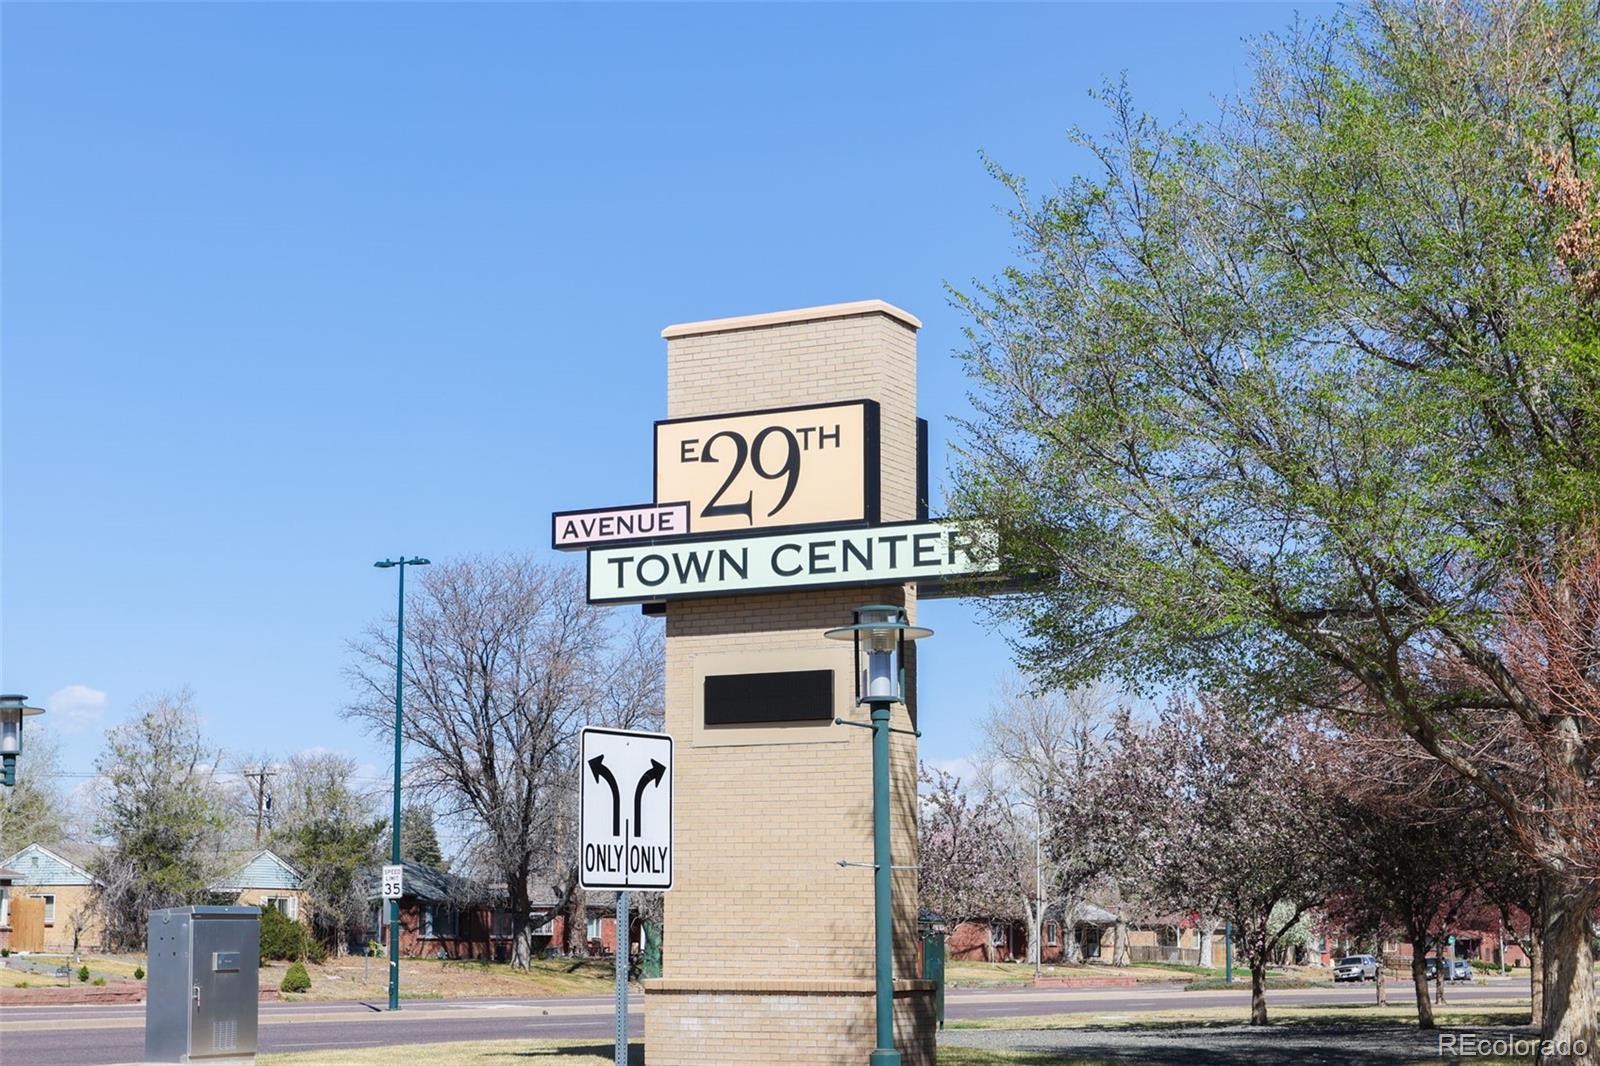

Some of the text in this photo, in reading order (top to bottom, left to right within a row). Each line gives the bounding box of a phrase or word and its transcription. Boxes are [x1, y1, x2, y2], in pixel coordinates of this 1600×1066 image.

[681, 439, 699, 463] E
[562, 511, 674, 540] AVENUE
[608, 530, 979, 588] TOWN CENTER
[585, 843, 624, 872] ONLY
[630, 844, 667, 873] ONLY
[384, 883, 400, 895] 35
